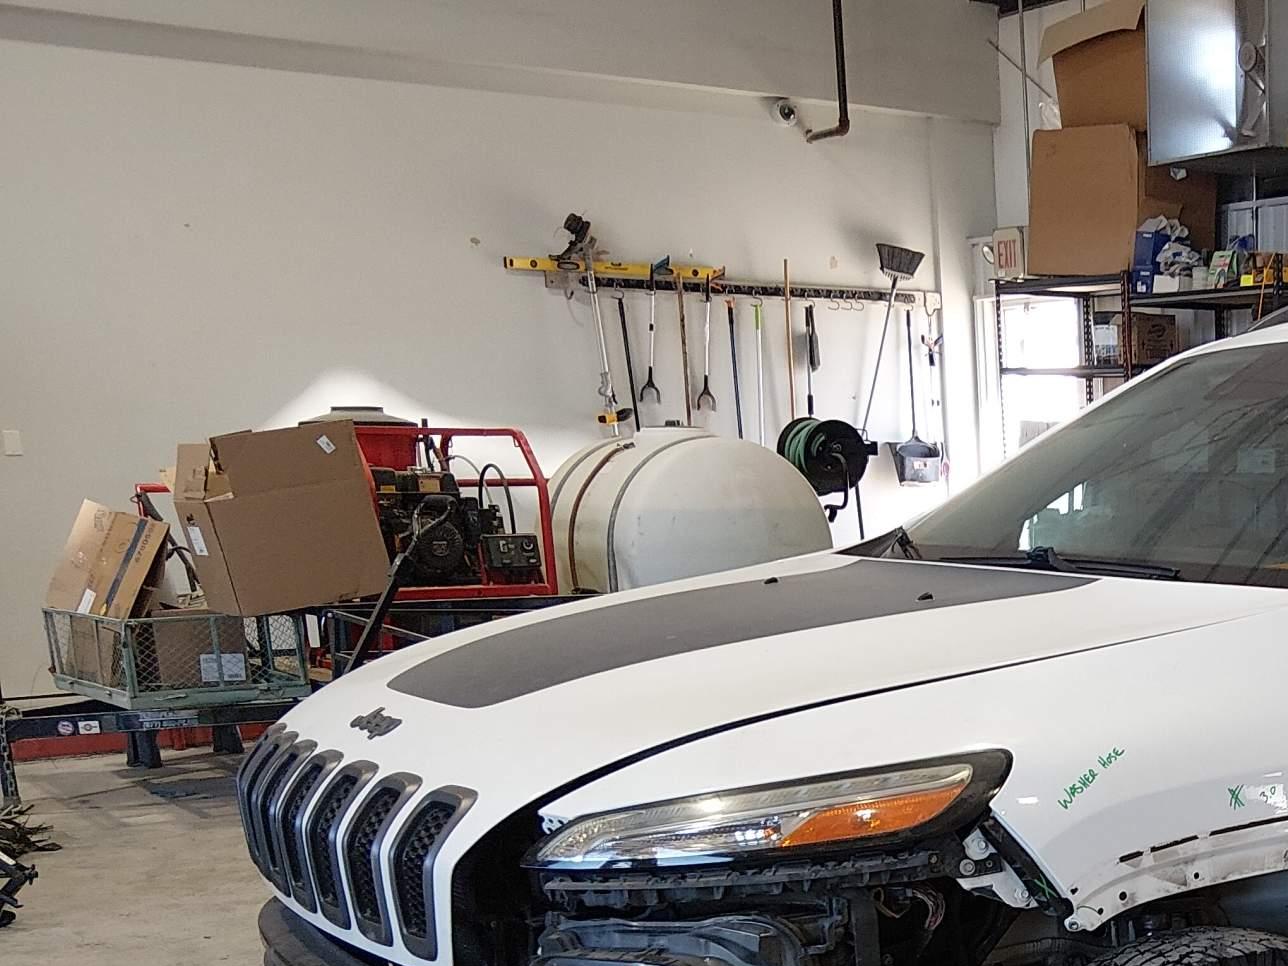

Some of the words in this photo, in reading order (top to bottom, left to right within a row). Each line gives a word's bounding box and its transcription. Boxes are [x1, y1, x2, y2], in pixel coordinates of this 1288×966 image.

[997, 239, 1017, 269] EXIT
[1057, 768, 1099, 810] WASHER
[1097, 747, 1125, 768] HOSE
